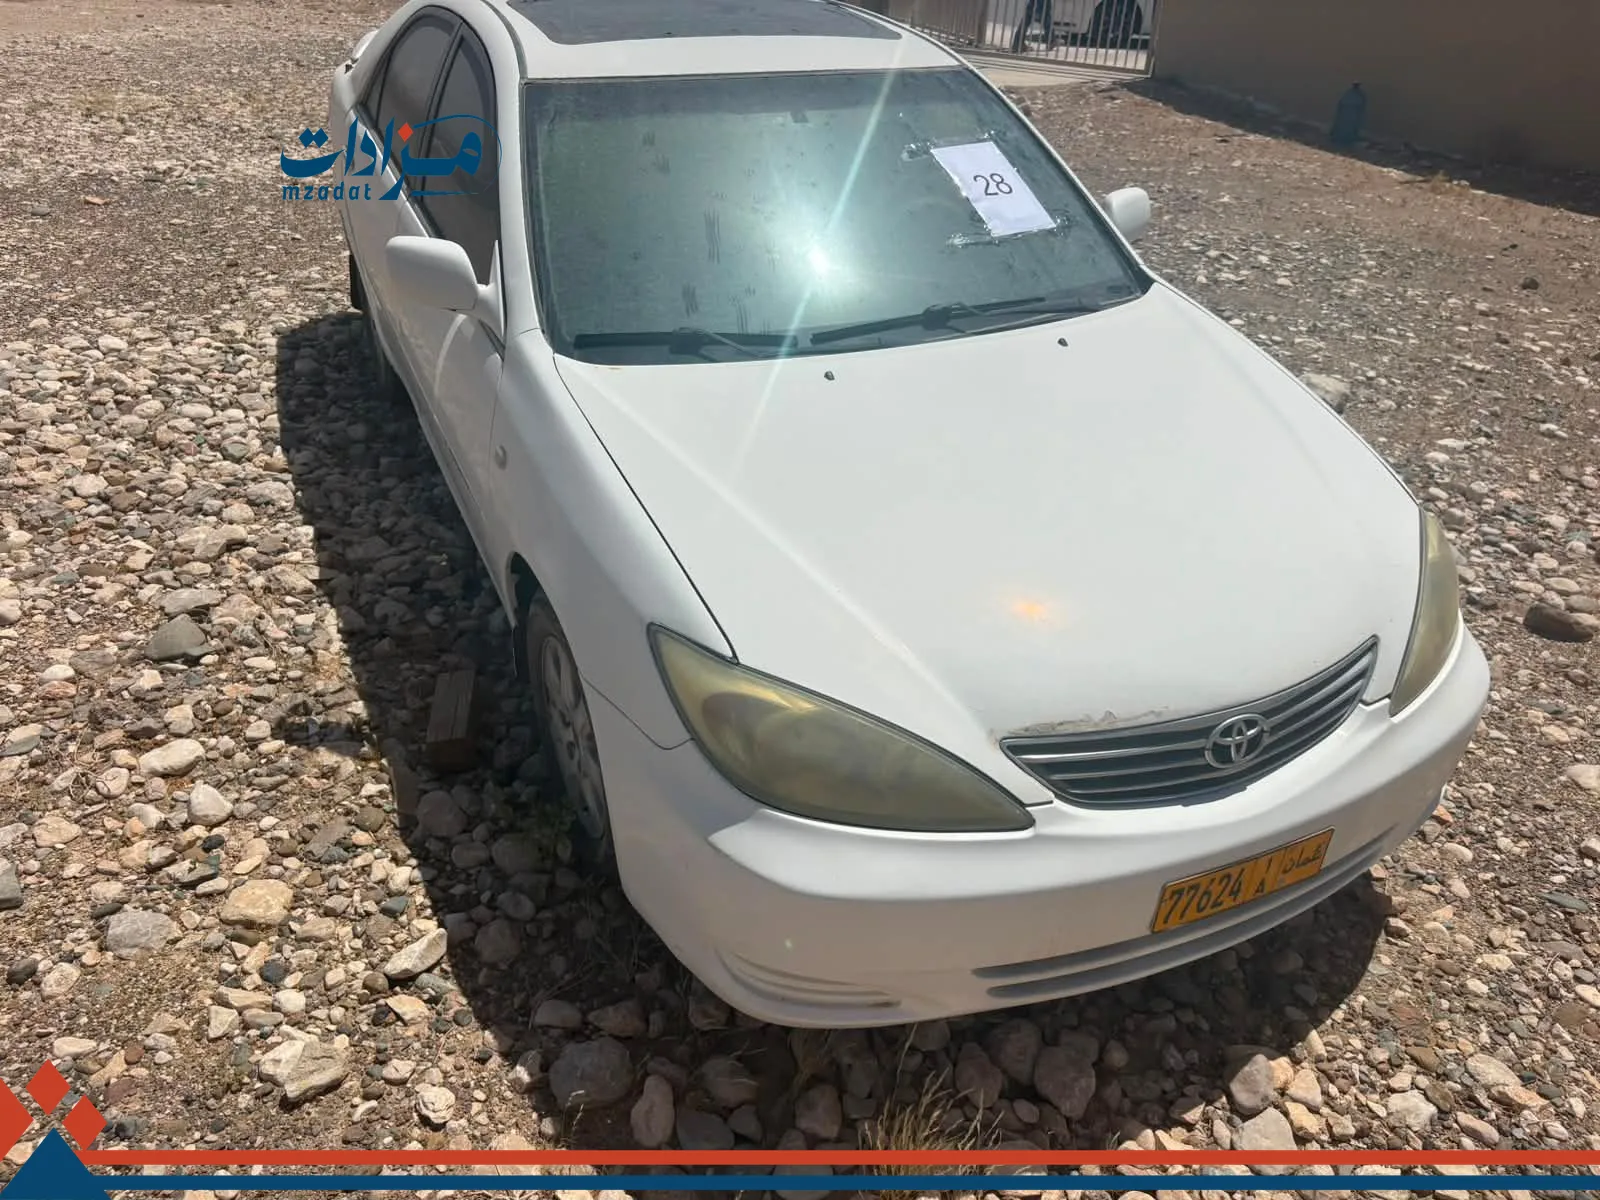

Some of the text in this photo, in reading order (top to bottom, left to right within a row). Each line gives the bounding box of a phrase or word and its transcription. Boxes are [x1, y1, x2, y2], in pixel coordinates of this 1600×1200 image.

[973, 172, 1013, 196] 28
[1162, 868, 1246, 925] 77624
[1255, 878, 1267, 895] A
